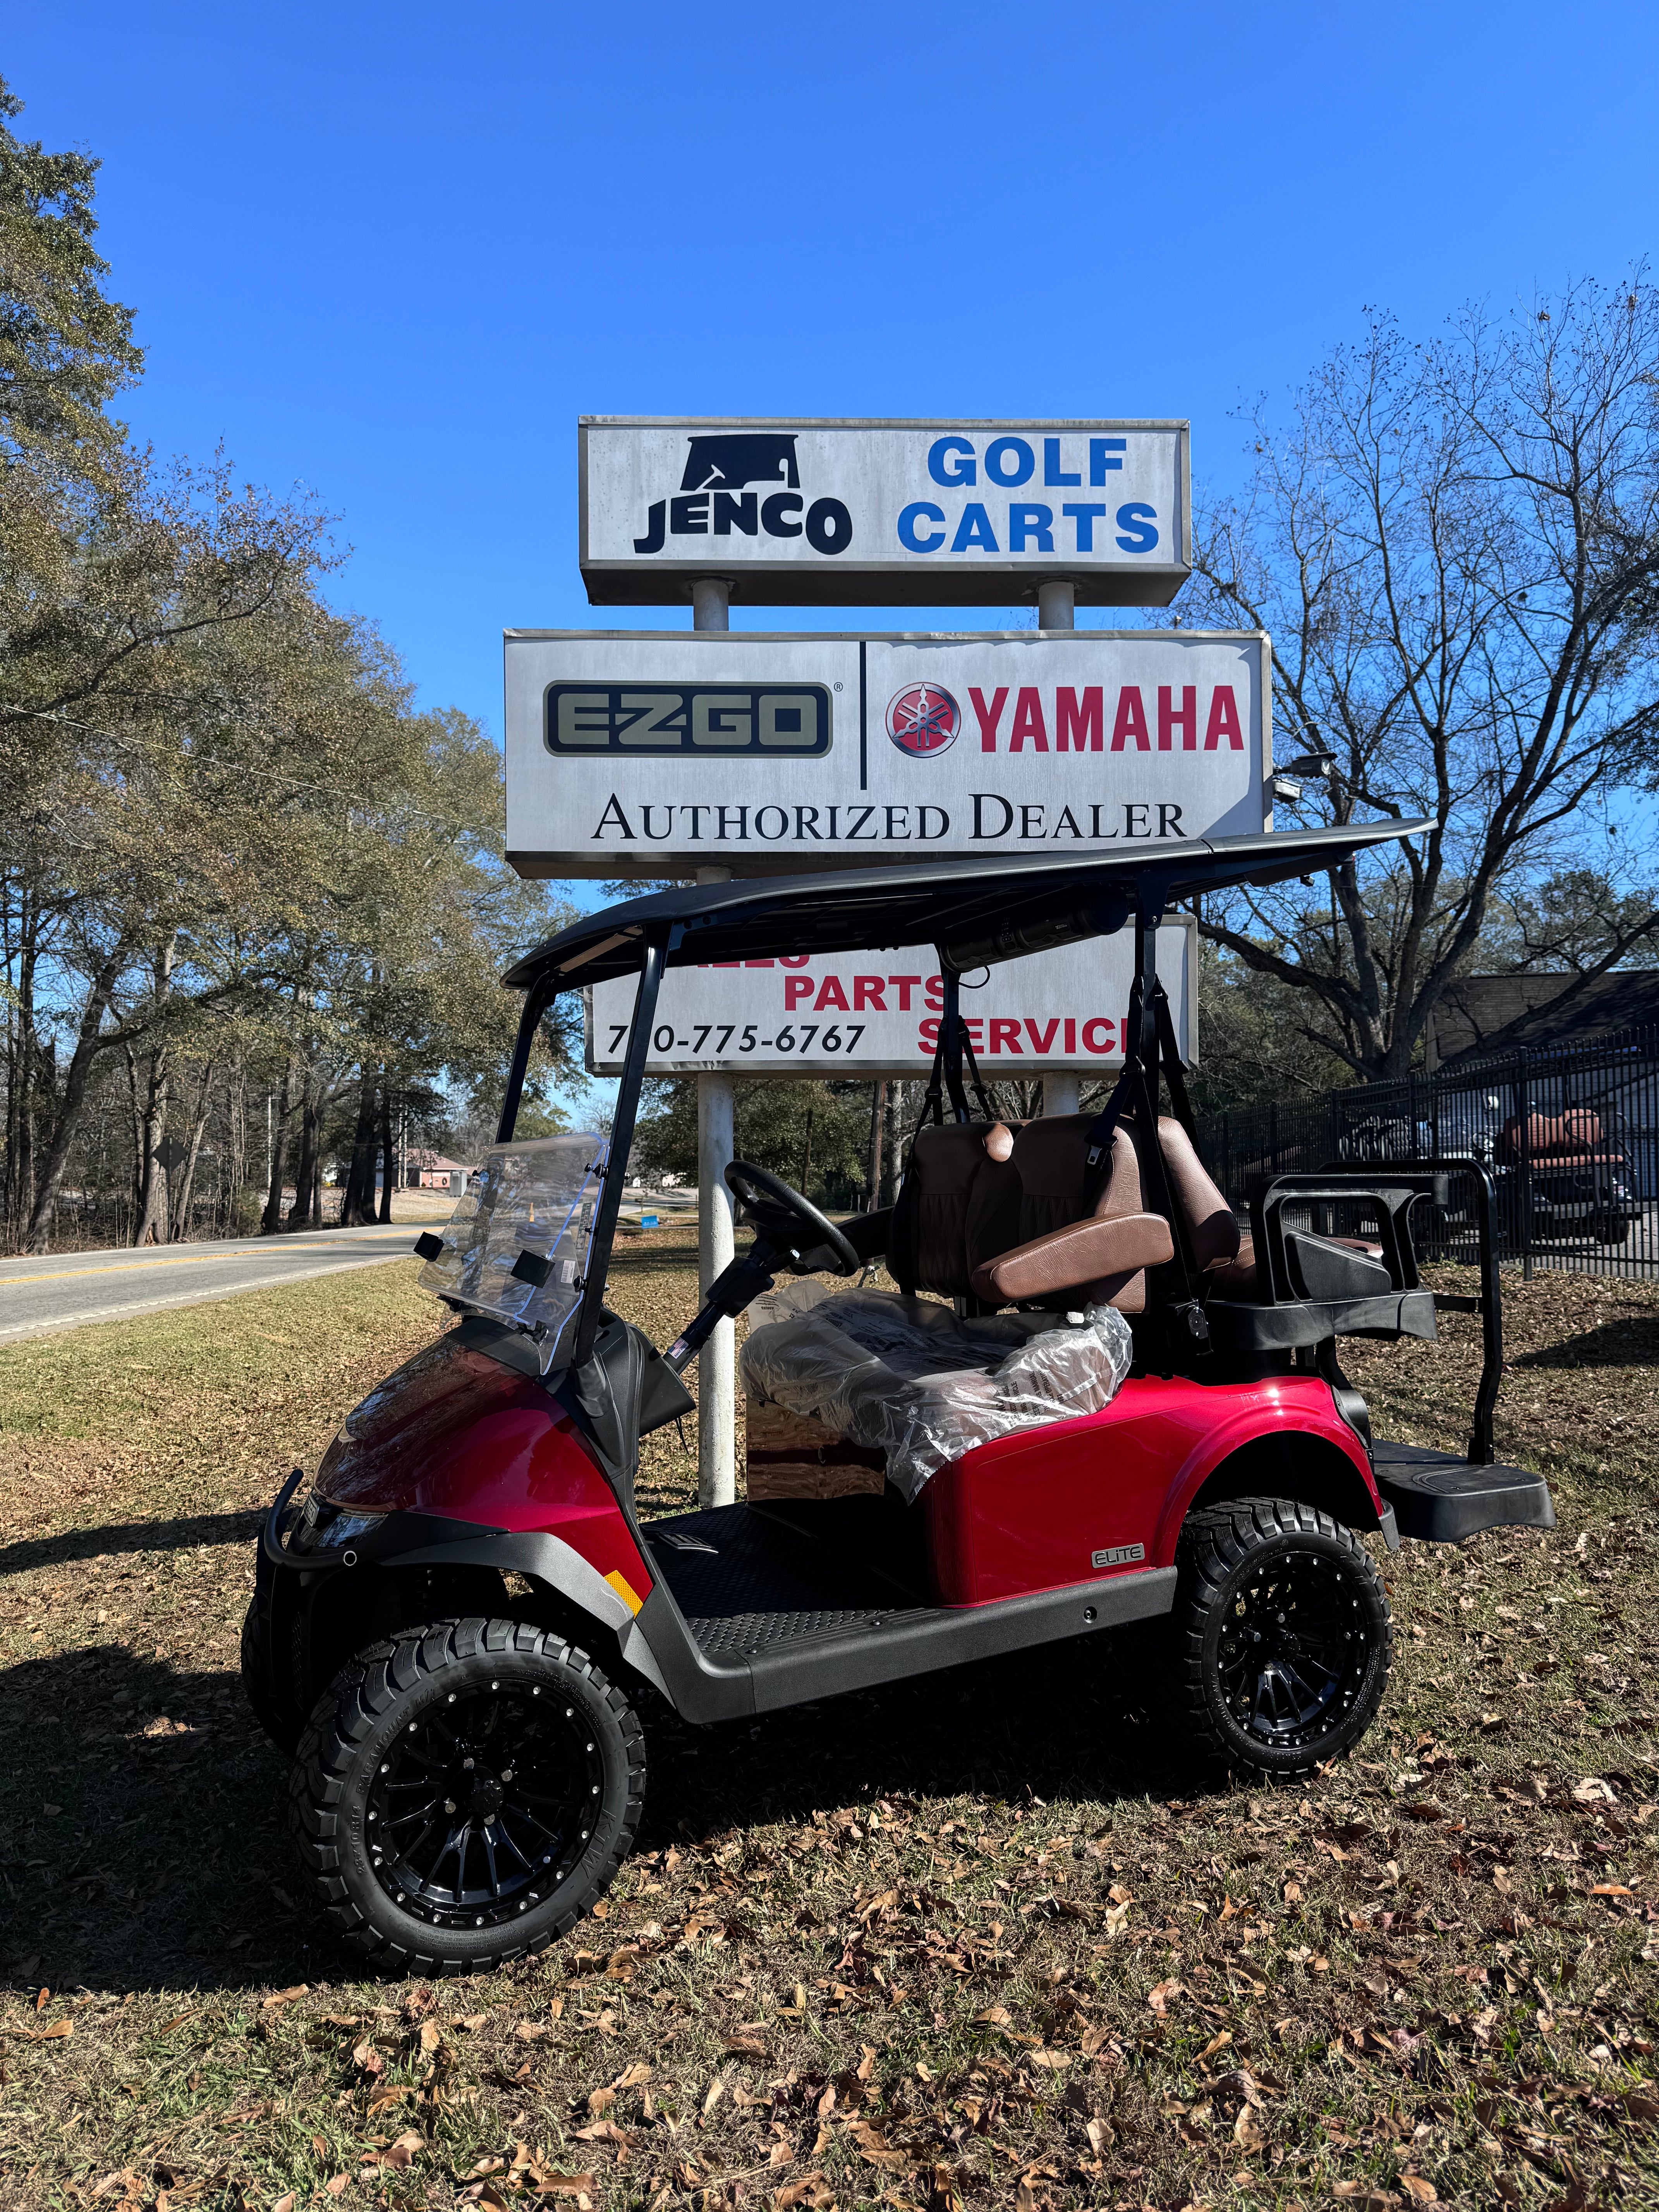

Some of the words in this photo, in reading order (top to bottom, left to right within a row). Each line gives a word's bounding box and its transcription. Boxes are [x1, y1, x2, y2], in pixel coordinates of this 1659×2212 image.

[927, 436, 1127, 488] GOLF
[633, 492, 853, 555] JENCO
[897, 502, 1159, 553] CARTS
[968, 685, 1243, 752] YAMAHA
[590, 793, 950, 840] AUTHORIZED
[968, 794, 1188, 839] DEALER
[785, 975, 944, 1011] PARTS
[608, 1025, 866, 1054] 70-775-6767
[918, 1018, 1128, 1054] SERVIC
[356, 1705, 410, 1794] PARAMOUNT
